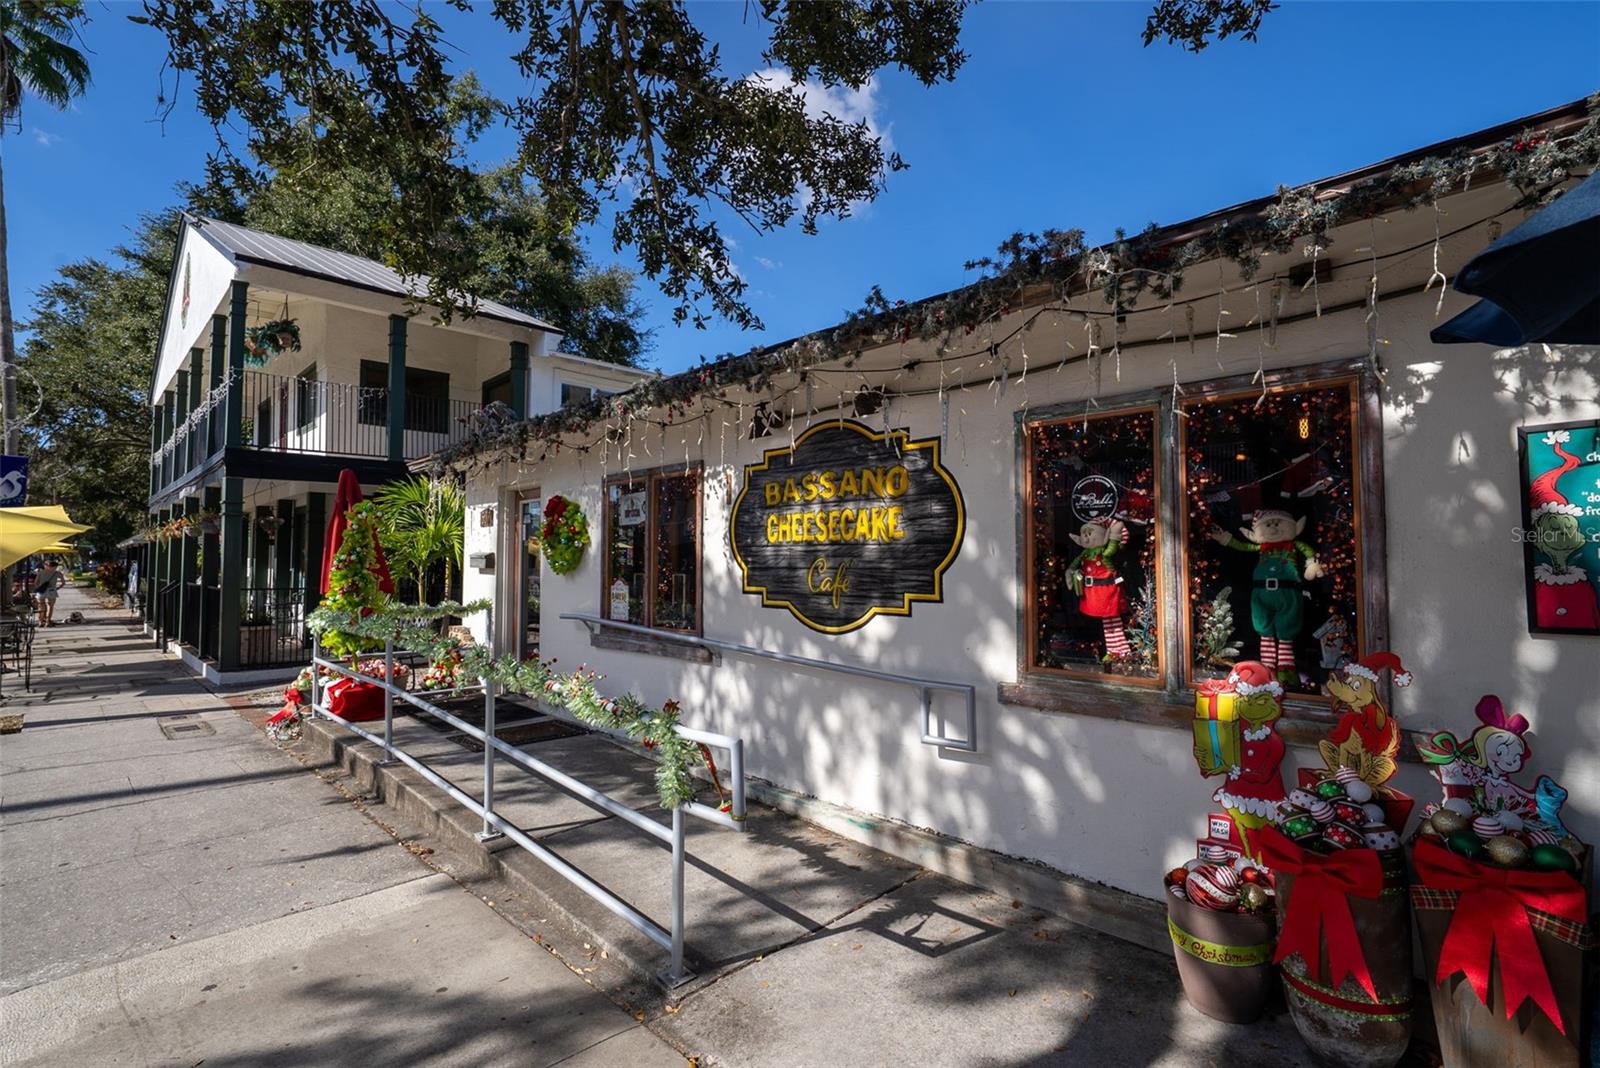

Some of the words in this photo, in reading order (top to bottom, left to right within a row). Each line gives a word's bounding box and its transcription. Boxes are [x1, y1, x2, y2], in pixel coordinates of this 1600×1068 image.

[765, 465, 911, 506] BASSANO
[767, 505, 905, 544] CHEESECAKE
[1211, 820, 1229, 829] WHO
